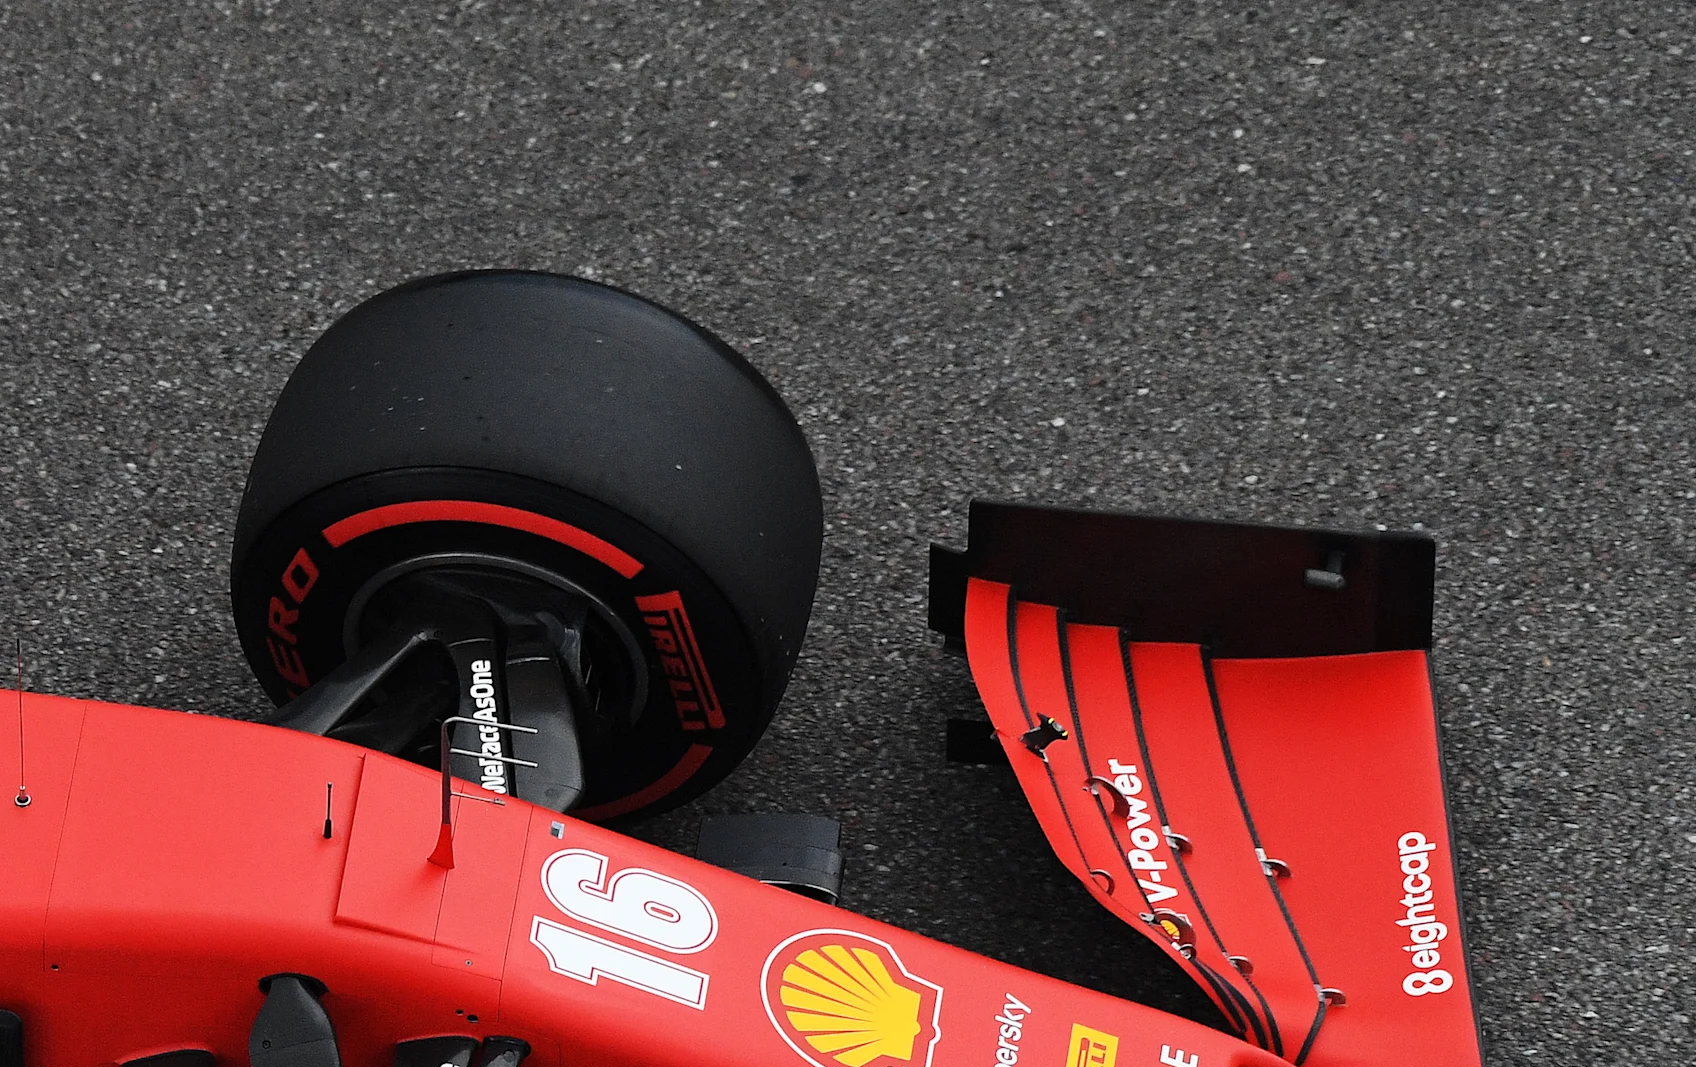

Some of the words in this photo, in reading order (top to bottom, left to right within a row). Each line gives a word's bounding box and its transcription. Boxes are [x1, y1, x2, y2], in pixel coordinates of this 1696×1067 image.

[266, 547, 320, 700] ERO
[634, 589, 726, 730] PIRELLI
[1107, 758, 1179, 904] V-Power
[529, 848, 719, 1011] 16
